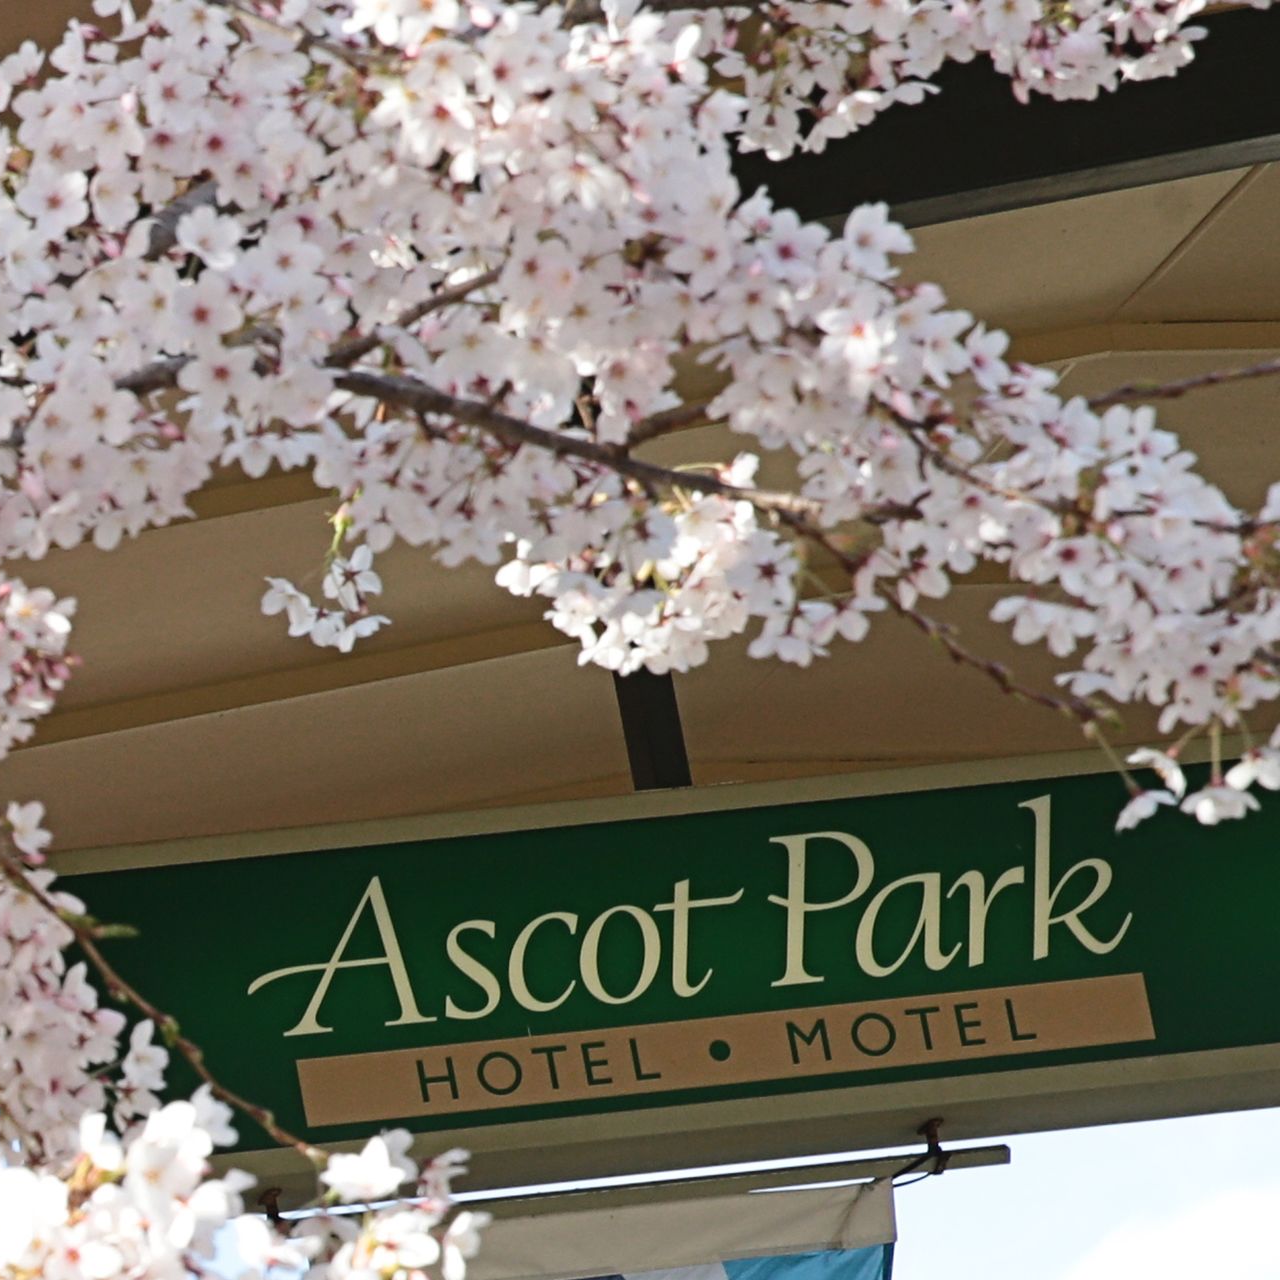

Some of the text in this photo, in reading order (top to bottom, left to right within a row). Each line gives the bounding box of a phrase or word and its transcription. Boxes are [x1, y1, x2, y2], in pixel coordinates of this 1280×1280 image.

[247, 793, 1133, 1037] Ascot Park
[415, 997, 1038, 1104] HOTEL MOTEL
